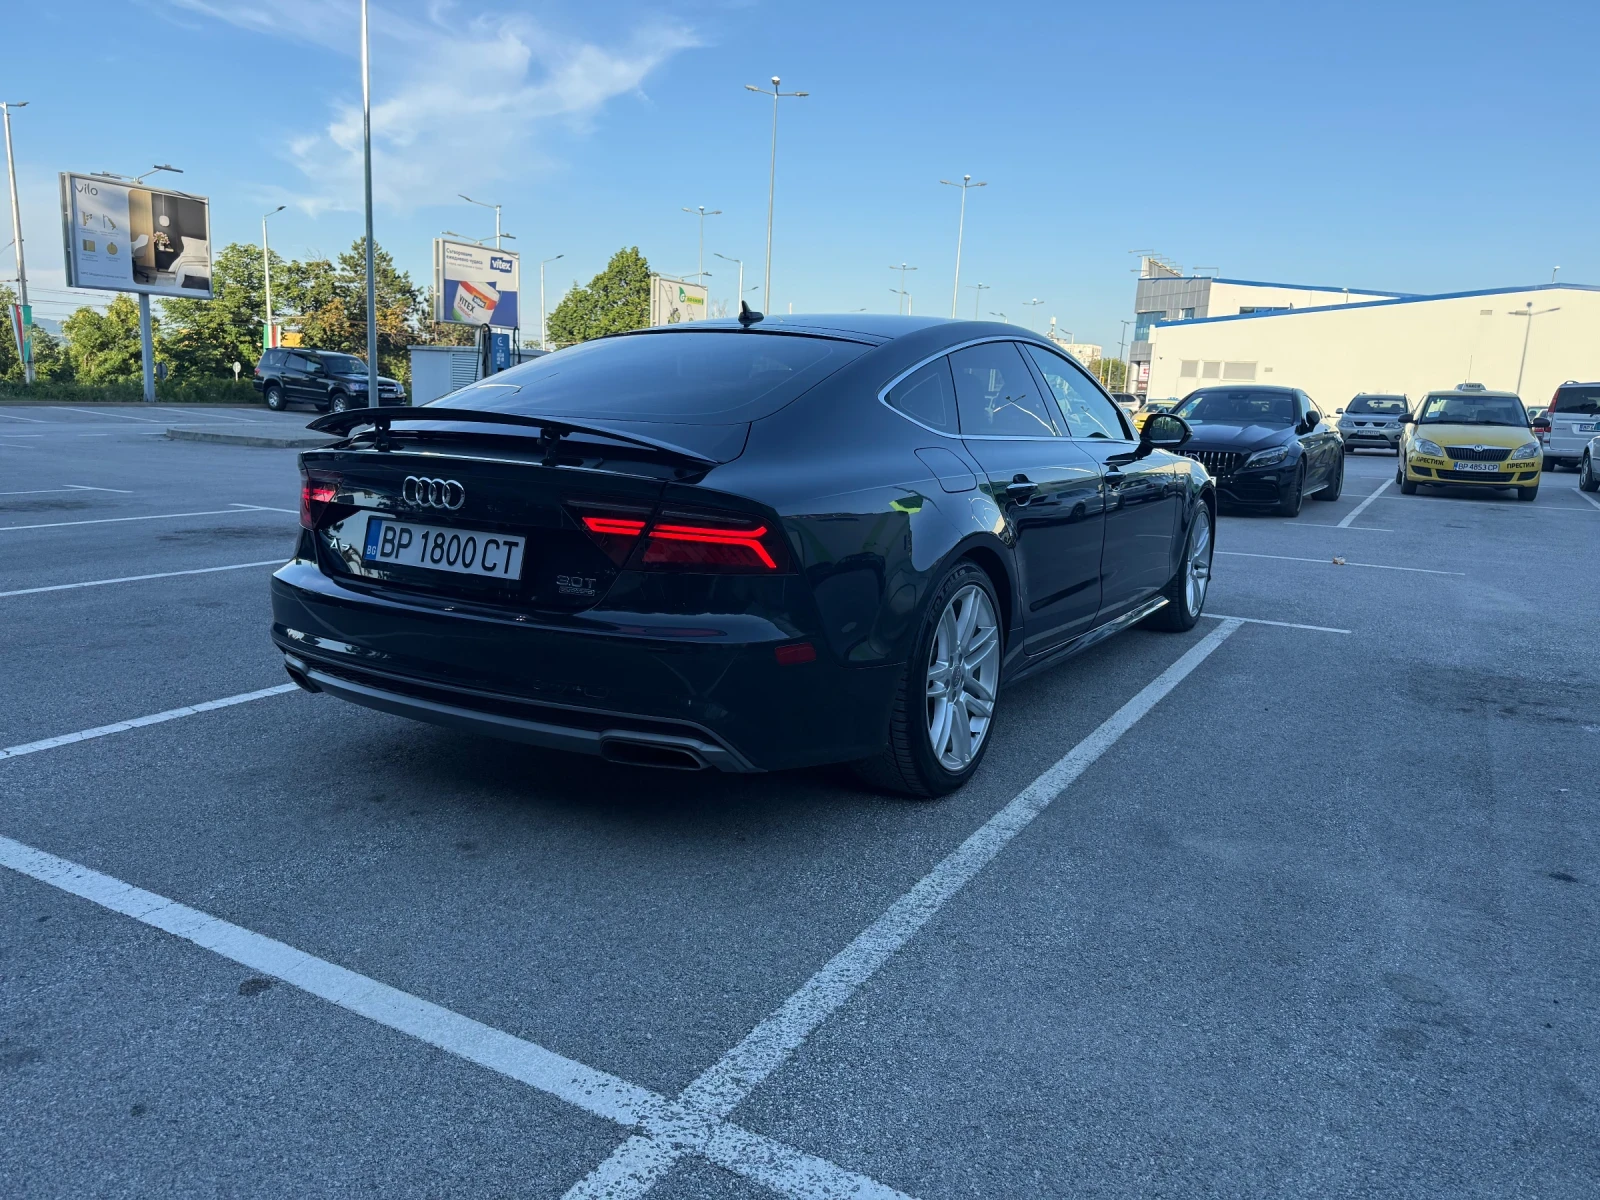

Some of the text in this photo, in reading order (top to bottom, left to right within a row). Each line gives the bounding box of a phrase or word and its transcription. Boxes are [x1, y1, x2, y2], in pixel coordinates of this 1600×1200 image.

[75, 183, 98, 196] vilo
[492, 260, 511, 270] vitex
[1416, 456, 1445, 466] ПРЕСТИЖ
[1506, 461, 1536, 469] ПРЕСТИЖ
[1469, 463, 1487, 471] 4853
[366, 545, 377, 555] BG
[380, 525, 520, 575] BP 1800 CT
